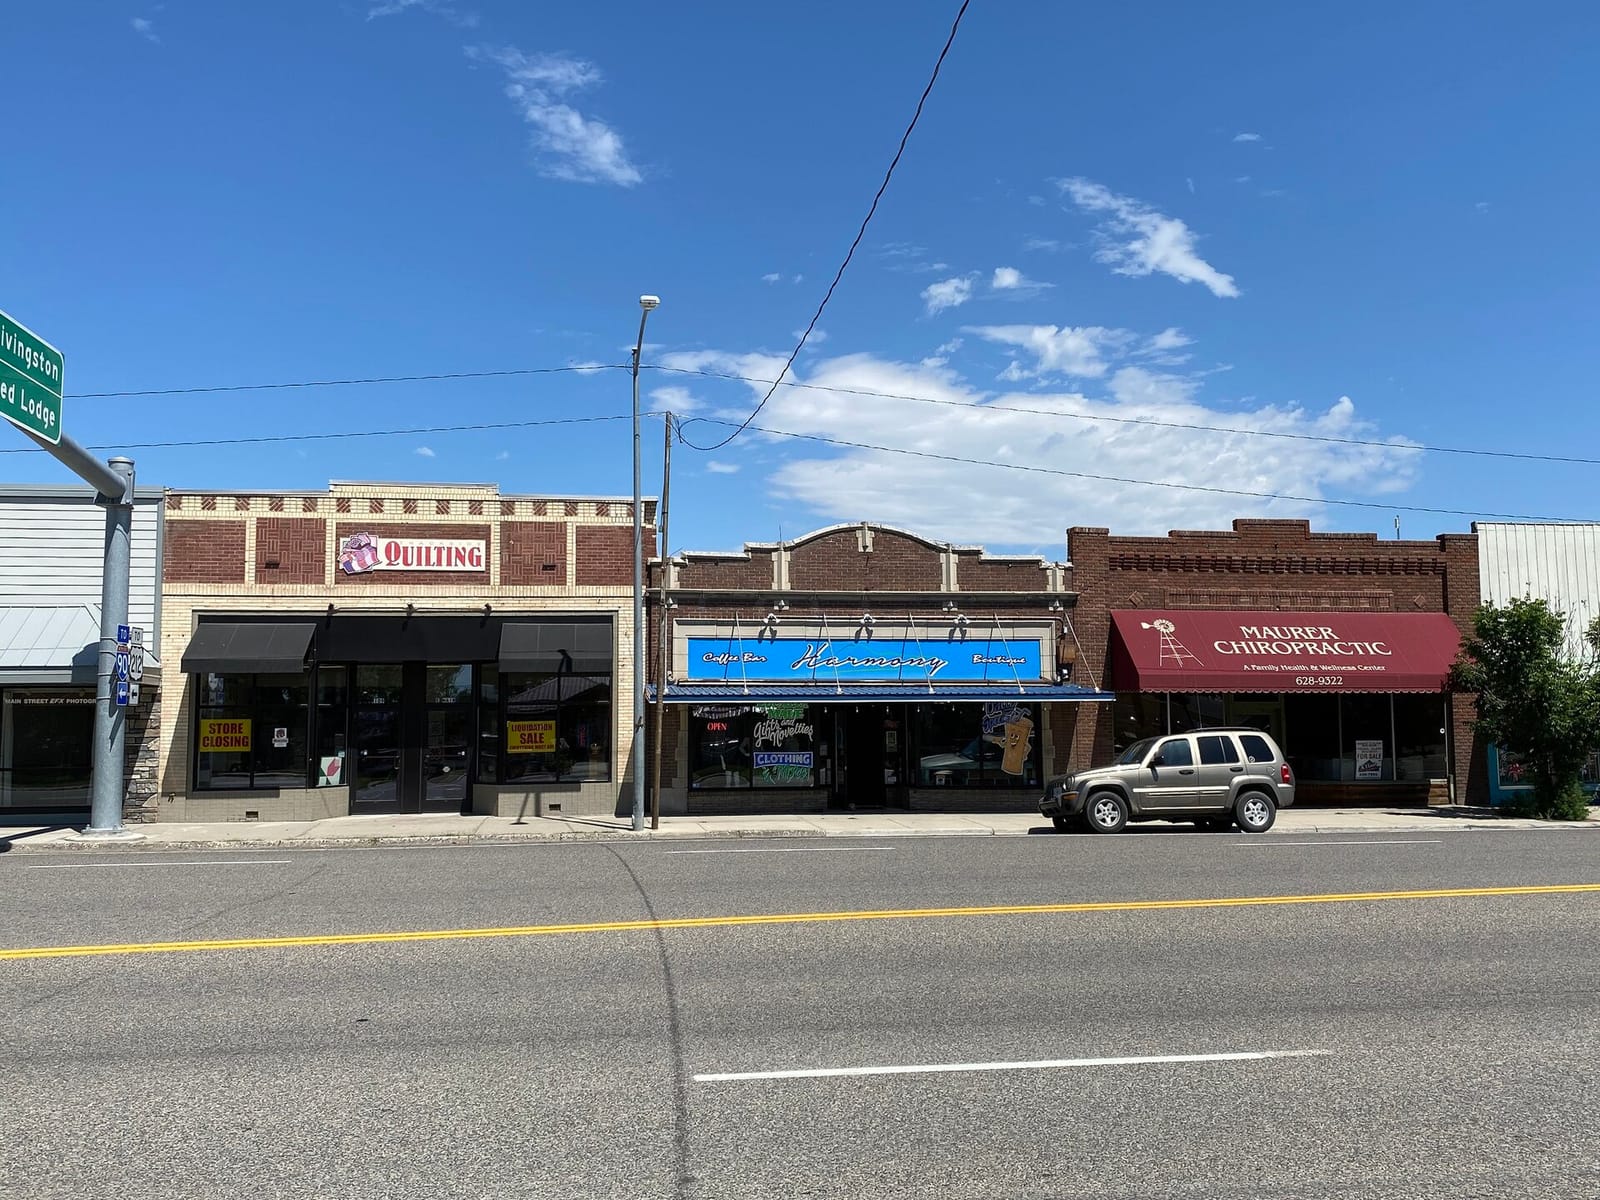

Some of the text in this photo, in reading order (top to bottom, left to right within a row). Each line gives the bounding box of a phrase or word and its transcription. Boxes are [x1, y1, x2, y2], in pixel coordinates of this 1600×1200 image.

[1, 325, 59, 381] ivingston
[0, 384, 56, 429] ed Lodge
[385, 541, 482, 568] QUILTING
[1240, 626, 1340, 640] MAURER
[1213, 641, 1392, 656] CHIROPRACTIC
[118, 654, 128, 674] 90
[131, 654, 141, 673] 212
[703, 653, 767, 666] Coffee Bar
[791, 642, 948, 677] Harmony
[972, 654, 1027, 667] Boutique
[1251, 664, 1279, 672] Family
[1296, 676, 1344, 686] 628-9322
[209, 723, 243, 734] STORE
[512, 724, 552, 732] LIQUIDATION
[707, 722, 727, 731] OPEN
[754, 718, 795, 747] Gifts and
[520, 733, 544, 744] SALE
[769, 723, 814, 747] Novelties
[202, 736, 249, 748] CLOSING
[757, 755, 810, 764] CLOTHING
